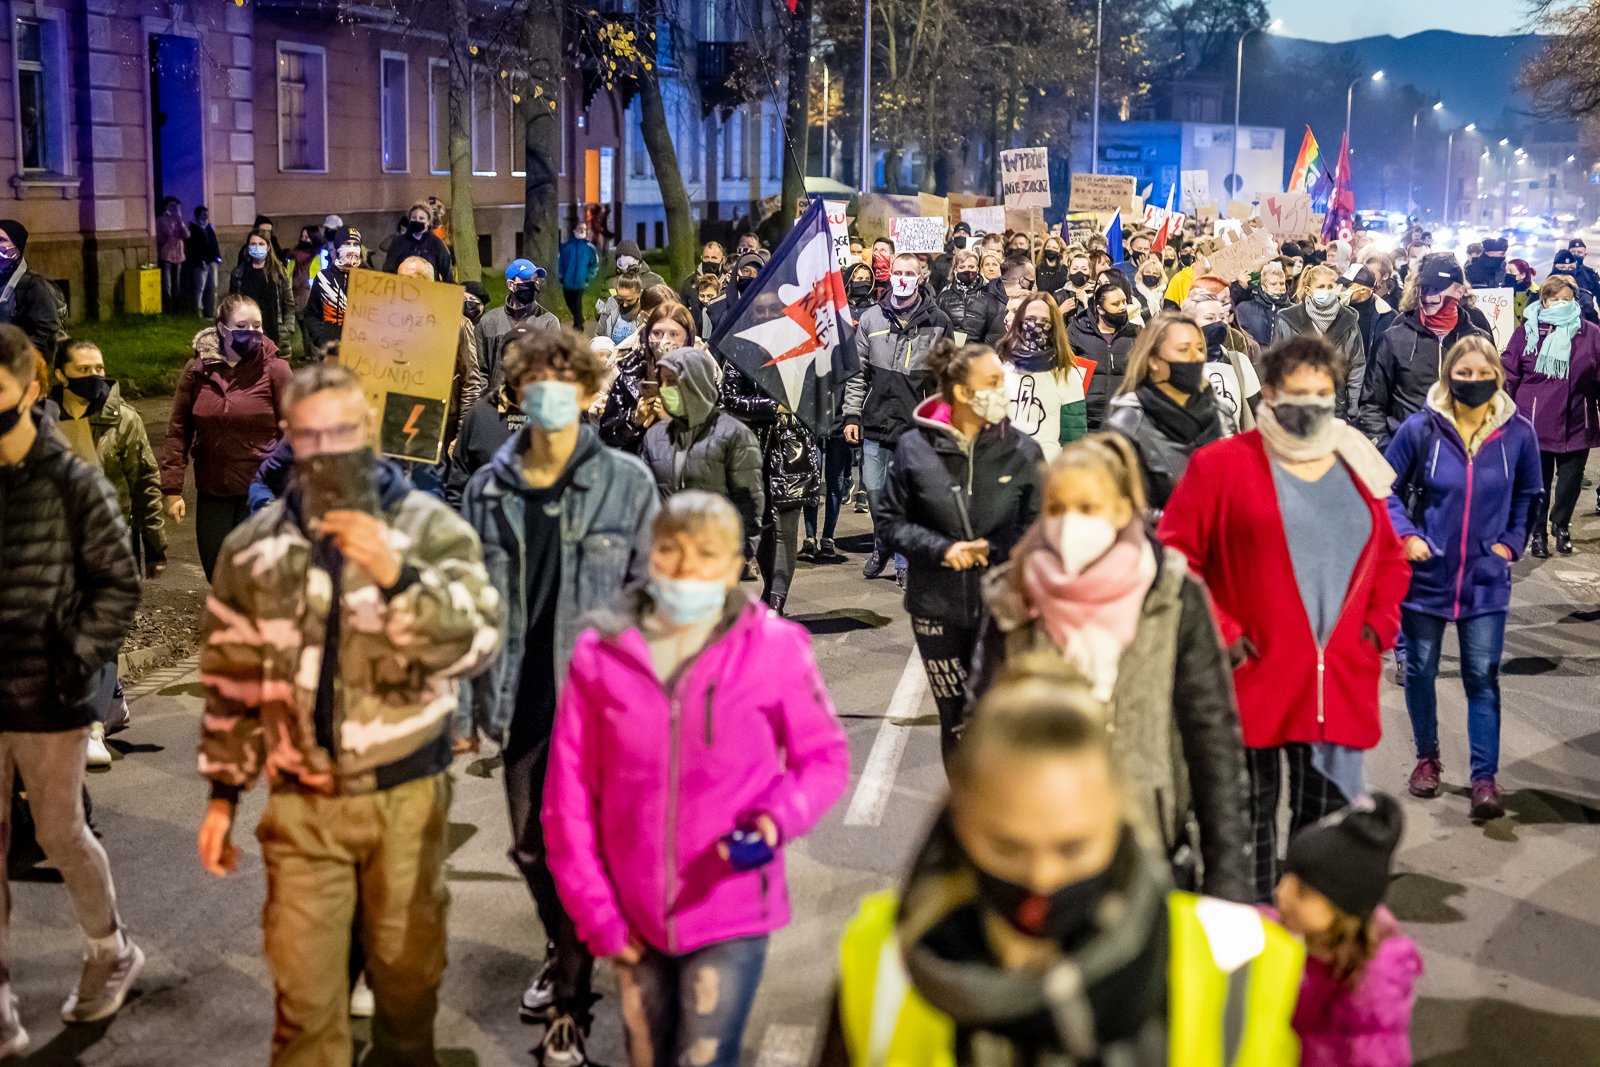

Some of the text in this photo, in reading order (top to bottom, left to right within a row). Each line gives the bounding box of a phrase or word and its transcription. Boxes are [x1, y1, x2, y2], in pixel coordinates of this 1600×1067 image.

[1005, 179, 1047, 195] NIE ZAKAZ
[351, 304, 379, 322] NIE
[348, 327, 366, 342] DA
